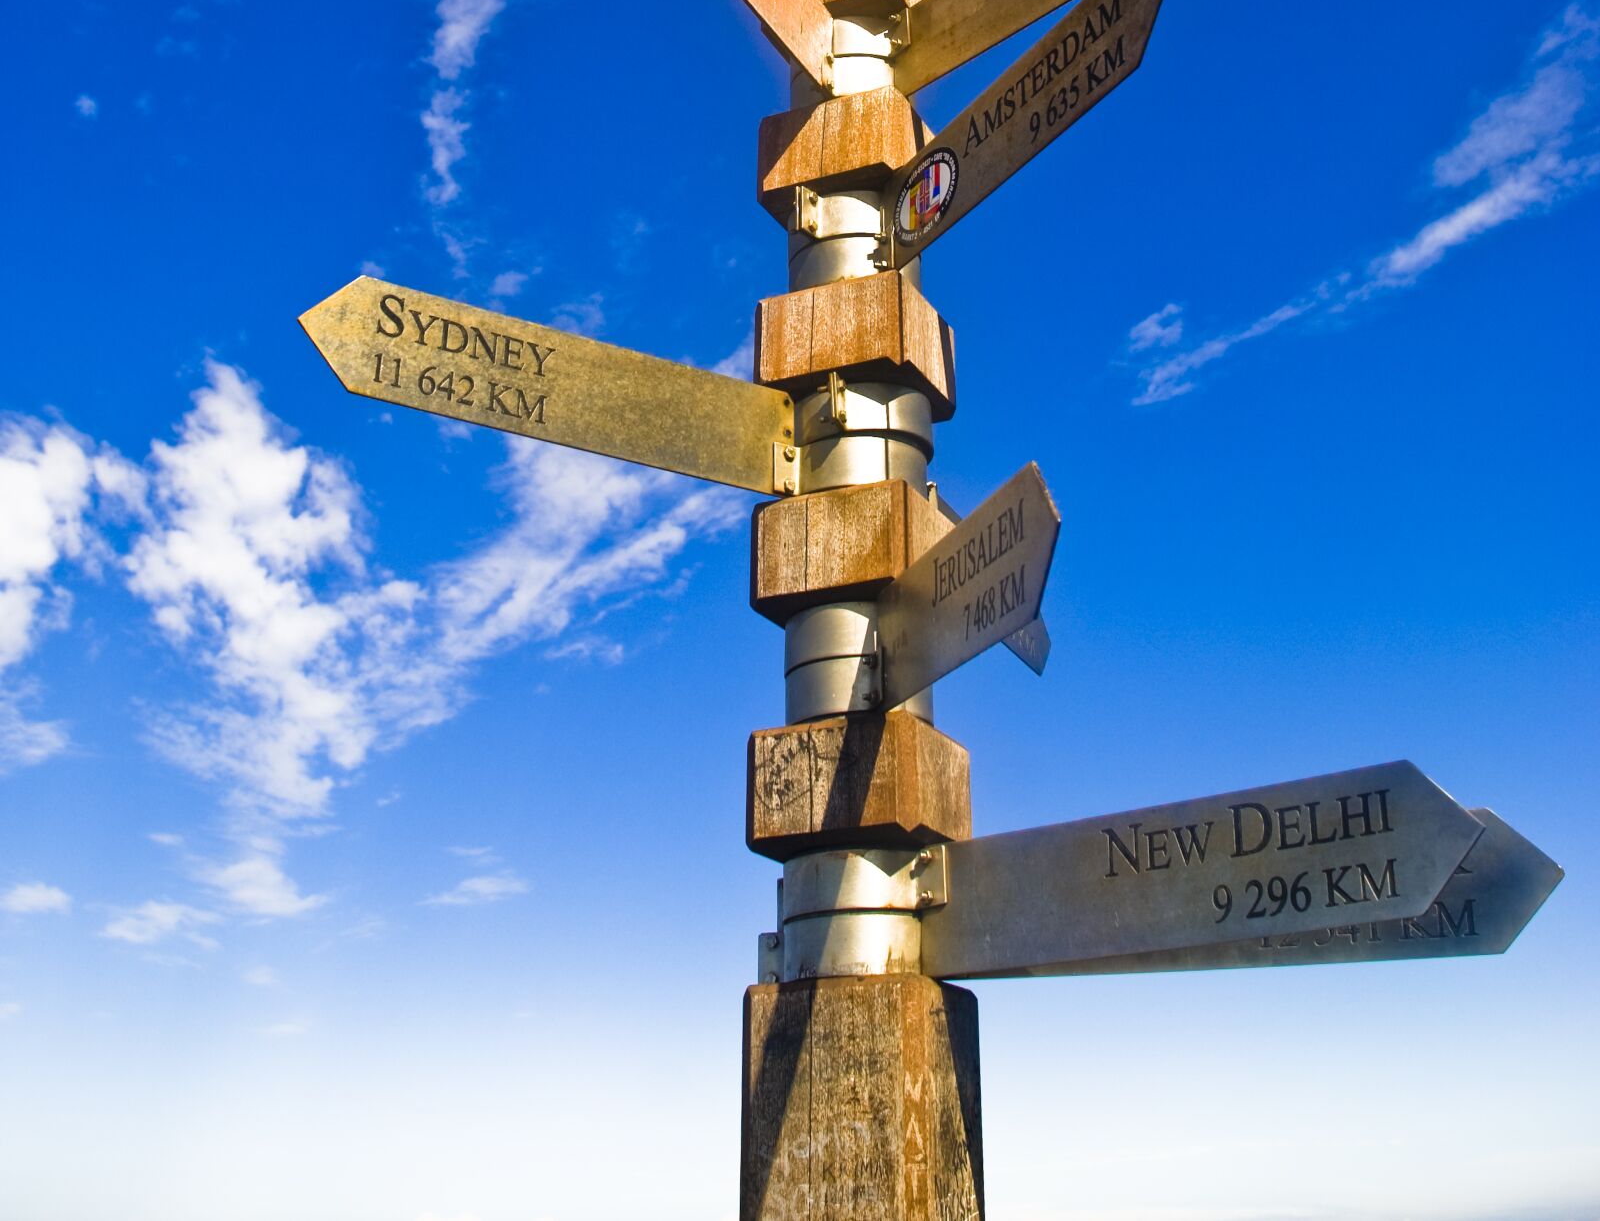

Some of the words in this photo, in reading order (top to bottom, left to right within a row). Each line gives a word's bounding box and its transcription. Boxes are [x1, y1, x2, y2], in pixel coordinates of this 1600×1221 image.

[1029, 111, 1041, 144] 9
[1046, 78, 1080, 126] 635
[1086, 34, 1126, 96] KM
[376, 294, 556, 378] SYDNEY
[373, 353, 402, 389] 11
[417, 366, 476, 406] 642
[487, 380, 548, 425] KM
[931, 497, 1025, 608] JERUSALEM
[963, 603, 971, 642] 7
[973, 586, 996, 633] 468
[999, 564, 1026, 620] KM
[1100, 821, 1215, 880] NEW
[1226, 789, 1395, 859] DELHI
[1212, 882, 1233, 925] 9
[1244, 871, 1312, 919] 296
[1322, 858, 1401, 908] KM
[1399, 899, 1479, 940] KM
